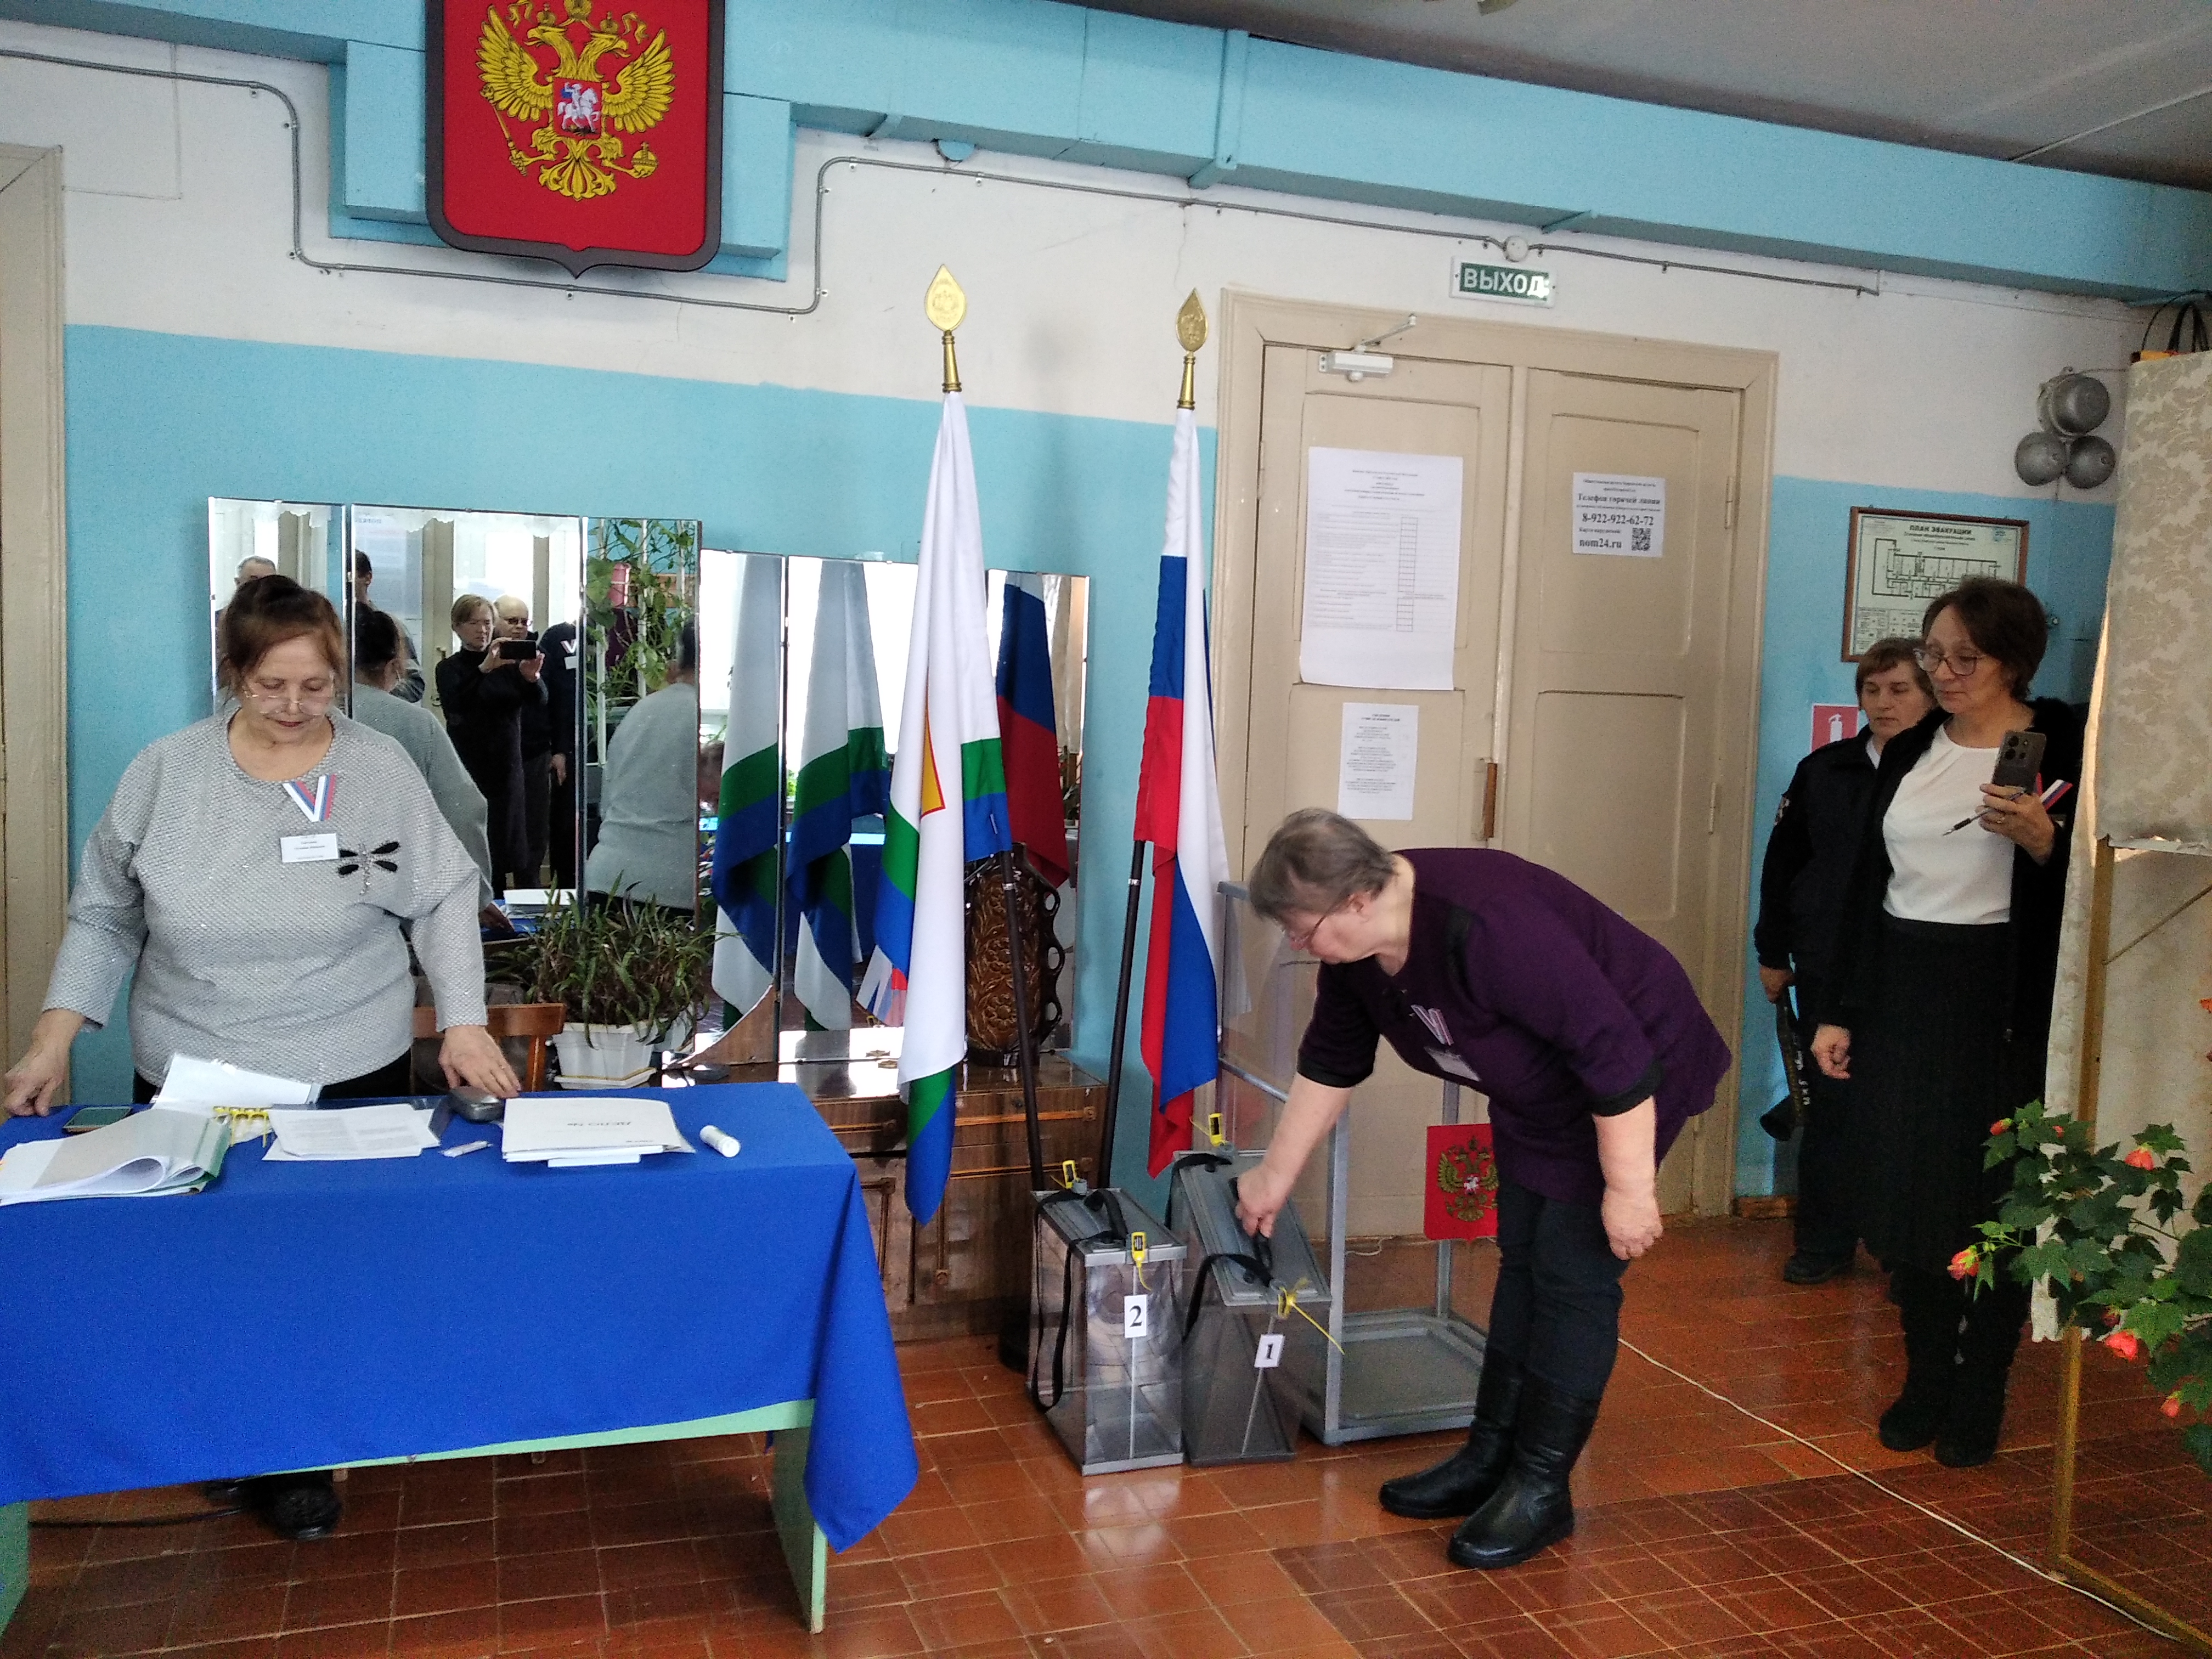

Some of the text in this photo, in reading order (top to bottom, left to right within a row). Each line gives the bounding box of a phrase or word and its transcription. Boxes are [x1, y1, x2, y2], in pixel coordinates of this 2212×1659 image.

[1464, 268, 1549, 298] ВЫХОД
[1578, 493, 1607, 503] Телефон
[1582, 513, 1654, 526] 8-922-922-62-72
[1579, 538, 1622, 549] nom24.ru
[1129, 1305, 1142, 1328] 2
[1266, 1343, 1273, 1360] 1
